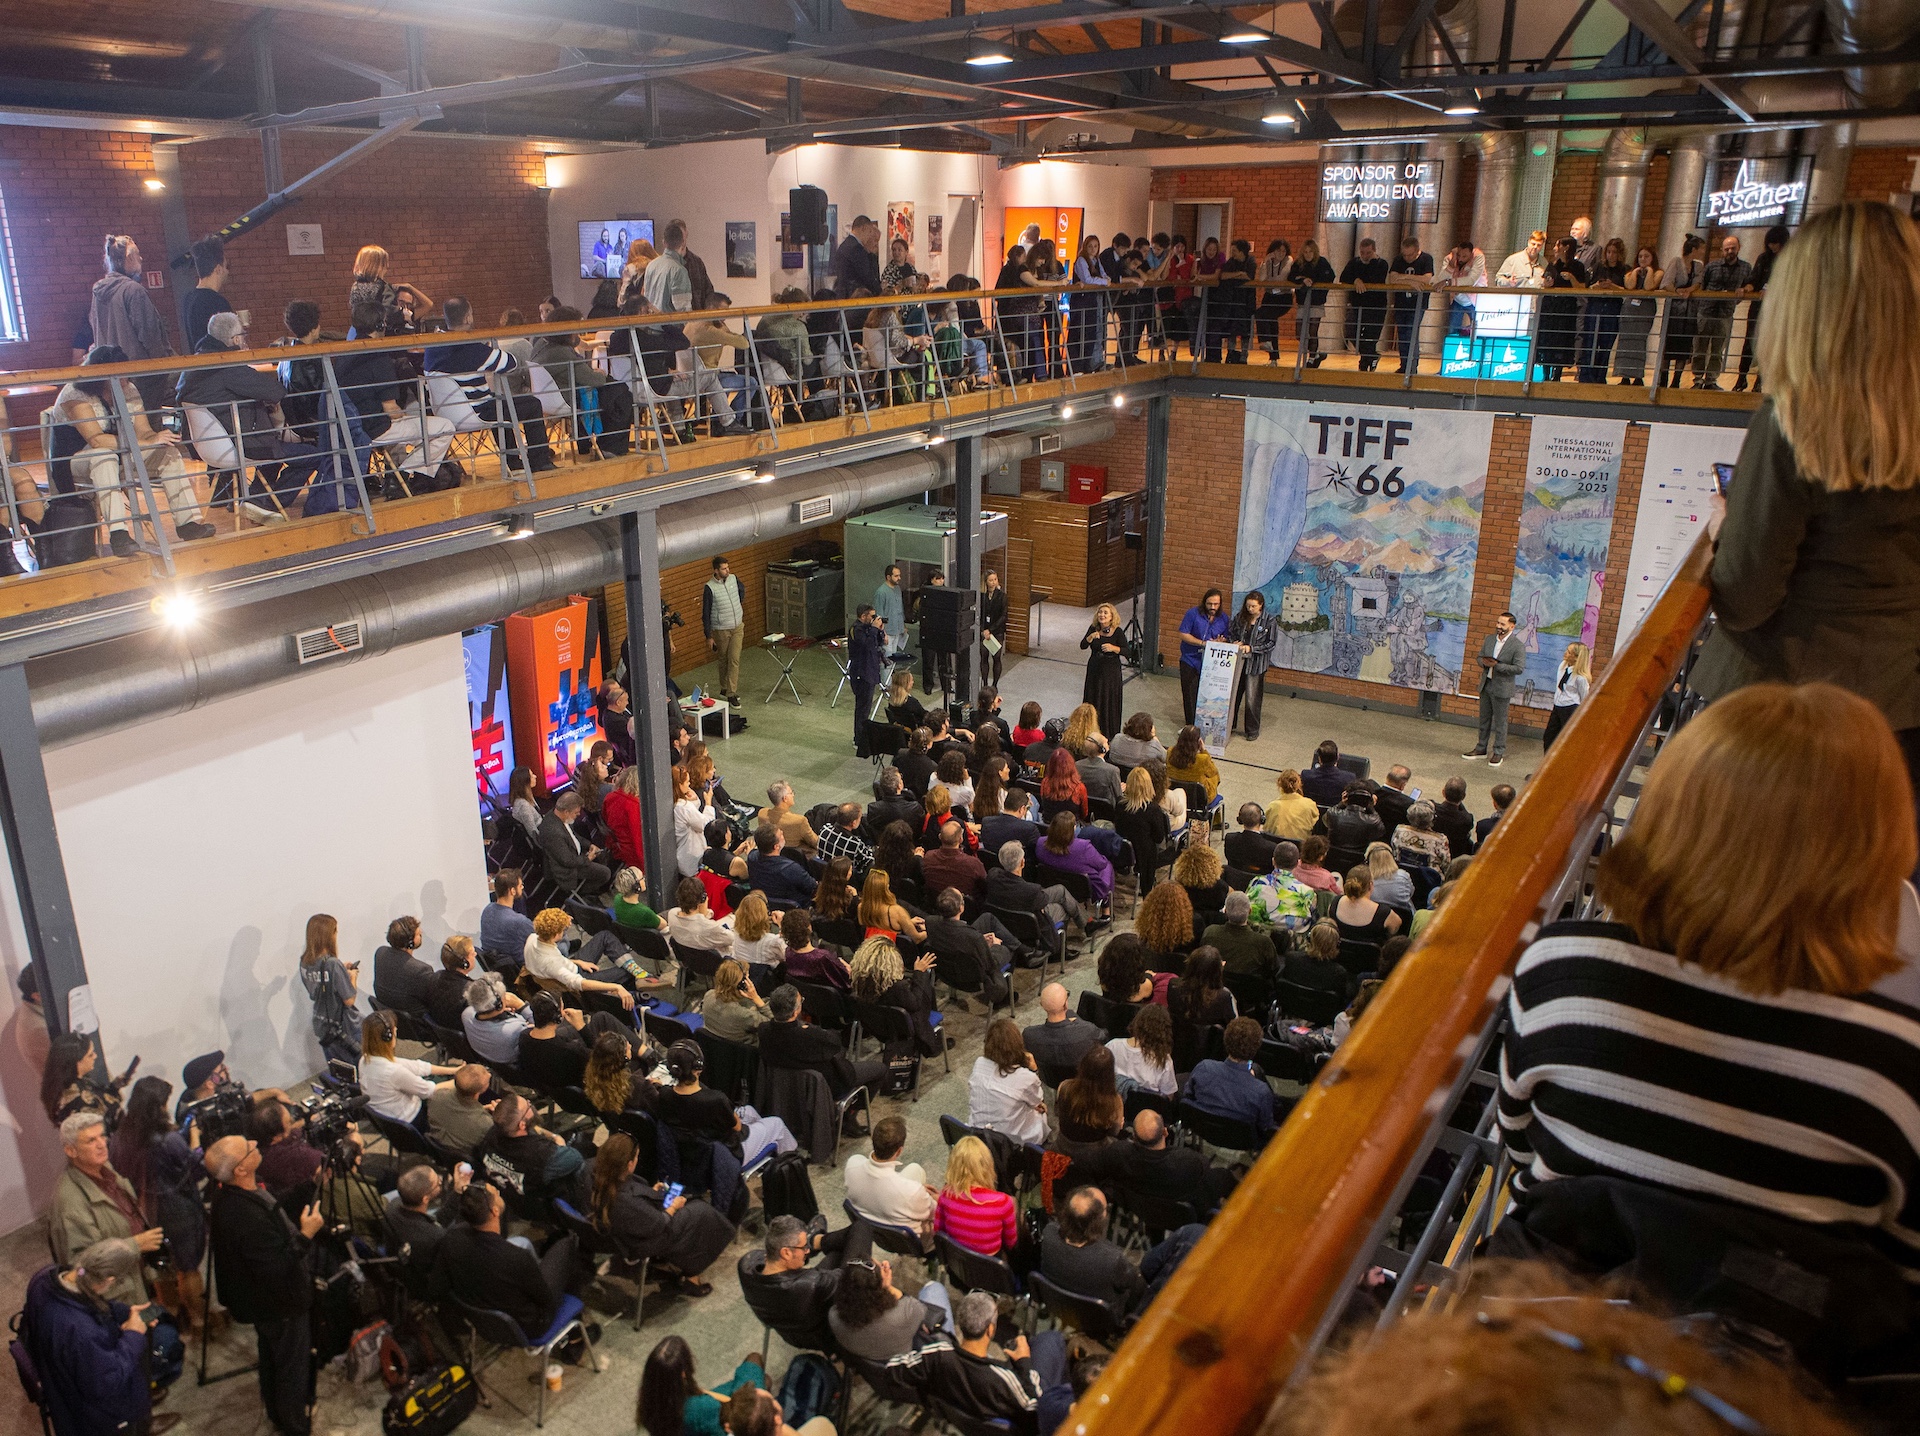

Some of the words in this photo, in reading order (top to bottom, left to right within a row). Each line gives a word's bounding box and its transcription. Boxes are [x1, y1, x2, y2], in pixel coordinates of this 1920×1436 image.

[1323, 165, 1396, 181] SPONSOR
[1404, 163, 1428, 179] OF
[1706, 181, 1804, 218] Fischer
[1326, 203, 1390, 218] AWARDS
[1718, 212, 1759, 226] PILSENER
[1759, 206, 1785, 219] BEER
[1480, 308, 1513, 322] Fischer
[1444, 359, 1479, 374] Fischer
[1492, 361, 1526, 377] Fischer
[1309, 415, 1413, 460] TiFF
[1553, 437, 1614, 448] THESSALONIKI
[1544, 444, 1613, 455] INTERNATIONAL
[1551, 452, 1571, 460] FILM
[1573, 453, 1612, 463] FESTIVAL
[1356, 464, 1405, 497] 66
[1535, 466, 1569, 478] 30.10
[1579, 470, 1609, 482] 09.11
[1577, 482, 1608, 493] 2025
[1210, 648, 1234, 659] TiFF
[491, 1153, 515, 1170] SOCIAL
